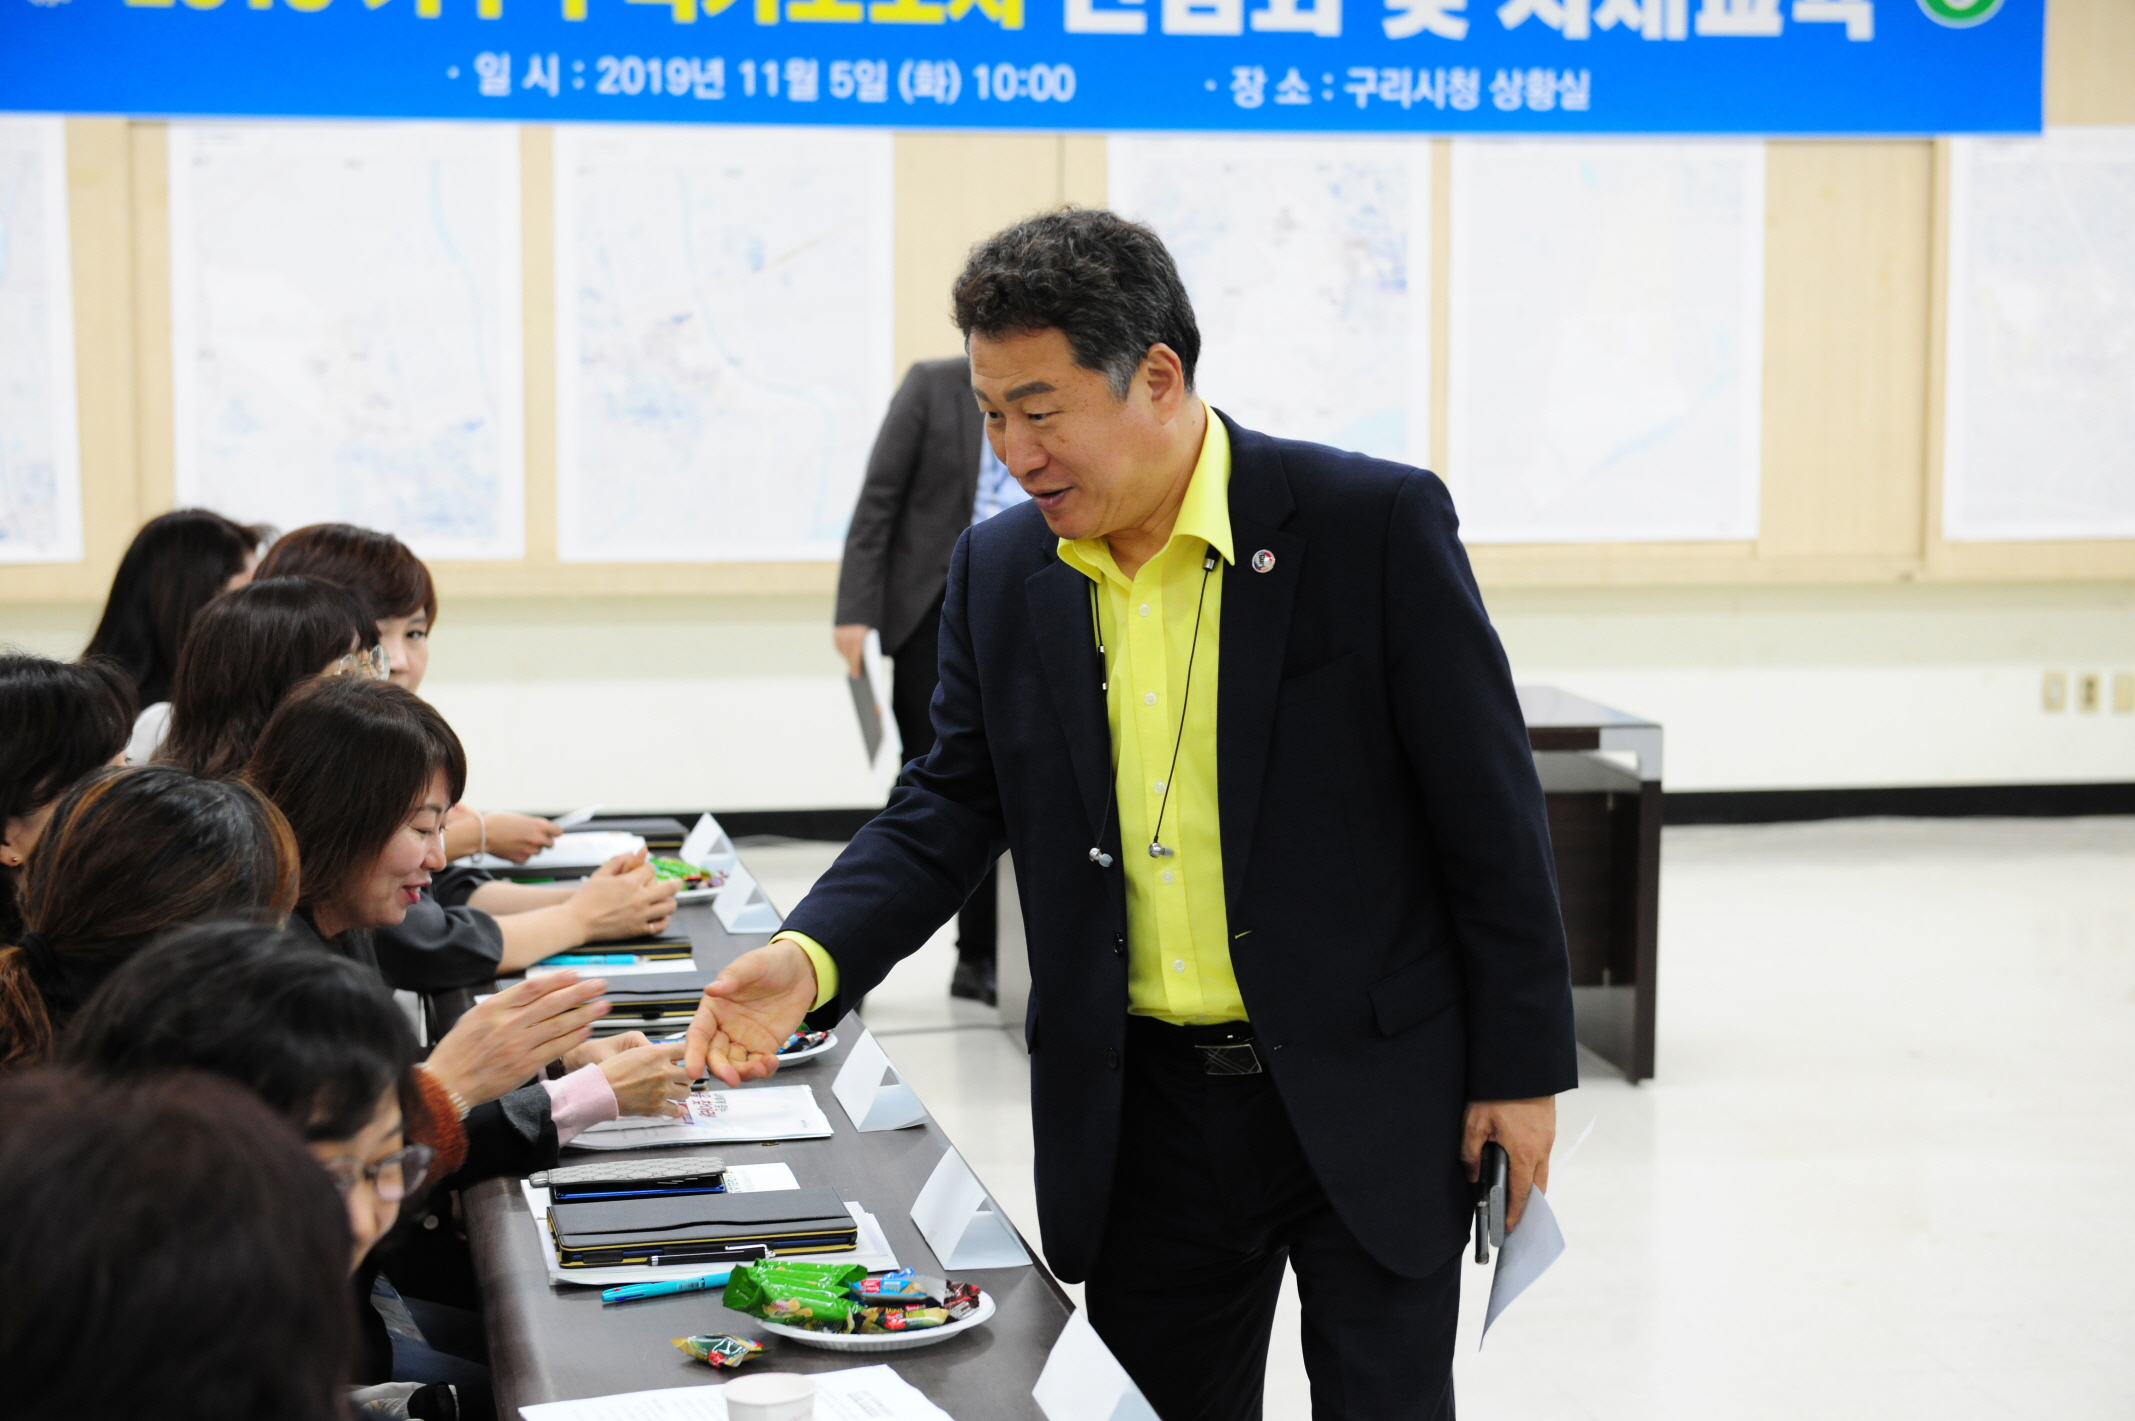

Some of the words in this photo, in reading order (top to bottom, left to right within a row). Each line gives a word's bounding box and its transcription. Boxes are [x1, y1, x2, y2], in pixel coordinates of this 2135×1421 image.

[475, 52, 511, 97] 일
[522, 54, 560, 97] 시
[596, 55, 725, 100] 2019년
[738, 58, 819, 102] 11월
[829, 59, 888, 103] 5일
[897, 59, 962, 104] (화)
[973, 62, 1077, 102] 10:00
[1230, 66, 1267, 109] 장
[1274, 67, 1312, 105] 소
[1343, 67, 1480, 110] 구리시청
[1488, 67, 1591, 111] 상황실
